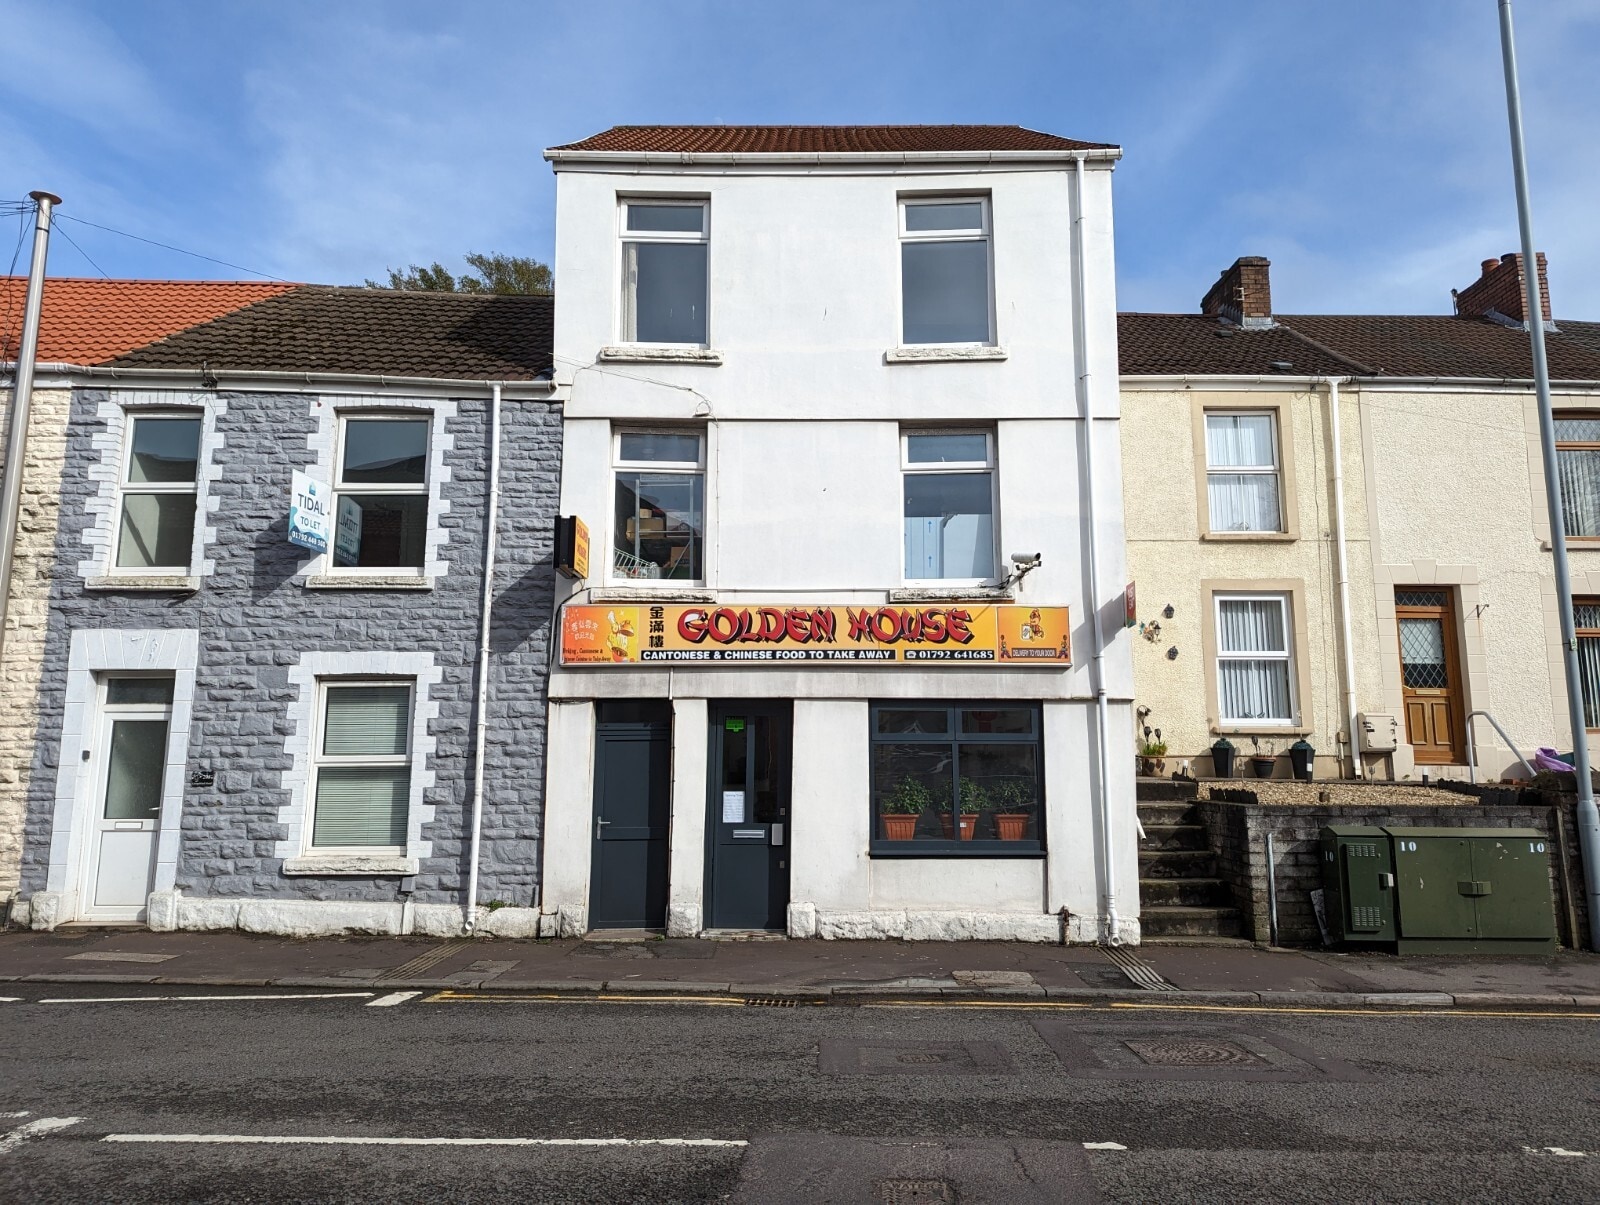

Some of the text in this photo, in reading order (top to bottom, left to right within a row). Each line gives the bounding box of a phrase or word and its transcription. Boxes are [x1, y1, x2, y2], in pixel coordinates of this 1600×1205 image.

[298, 493, 325, 516] TIDAL
[300, 516, 321, 529] TO LET
[649, 606, 664, 648] 金滿樓
[678, 606, 975, 644] GOLDEN HOUSE
[643, 650, 891, 660] CANTONESE & CHINESE FOOD TO TAKE AWAY
[919, 650, 993, 659] 01792 641685
[1400, 841, 1417, 852] 10
[1529, 842, 1545, 853] 10
[1324, 850, 1334, 862] 10
